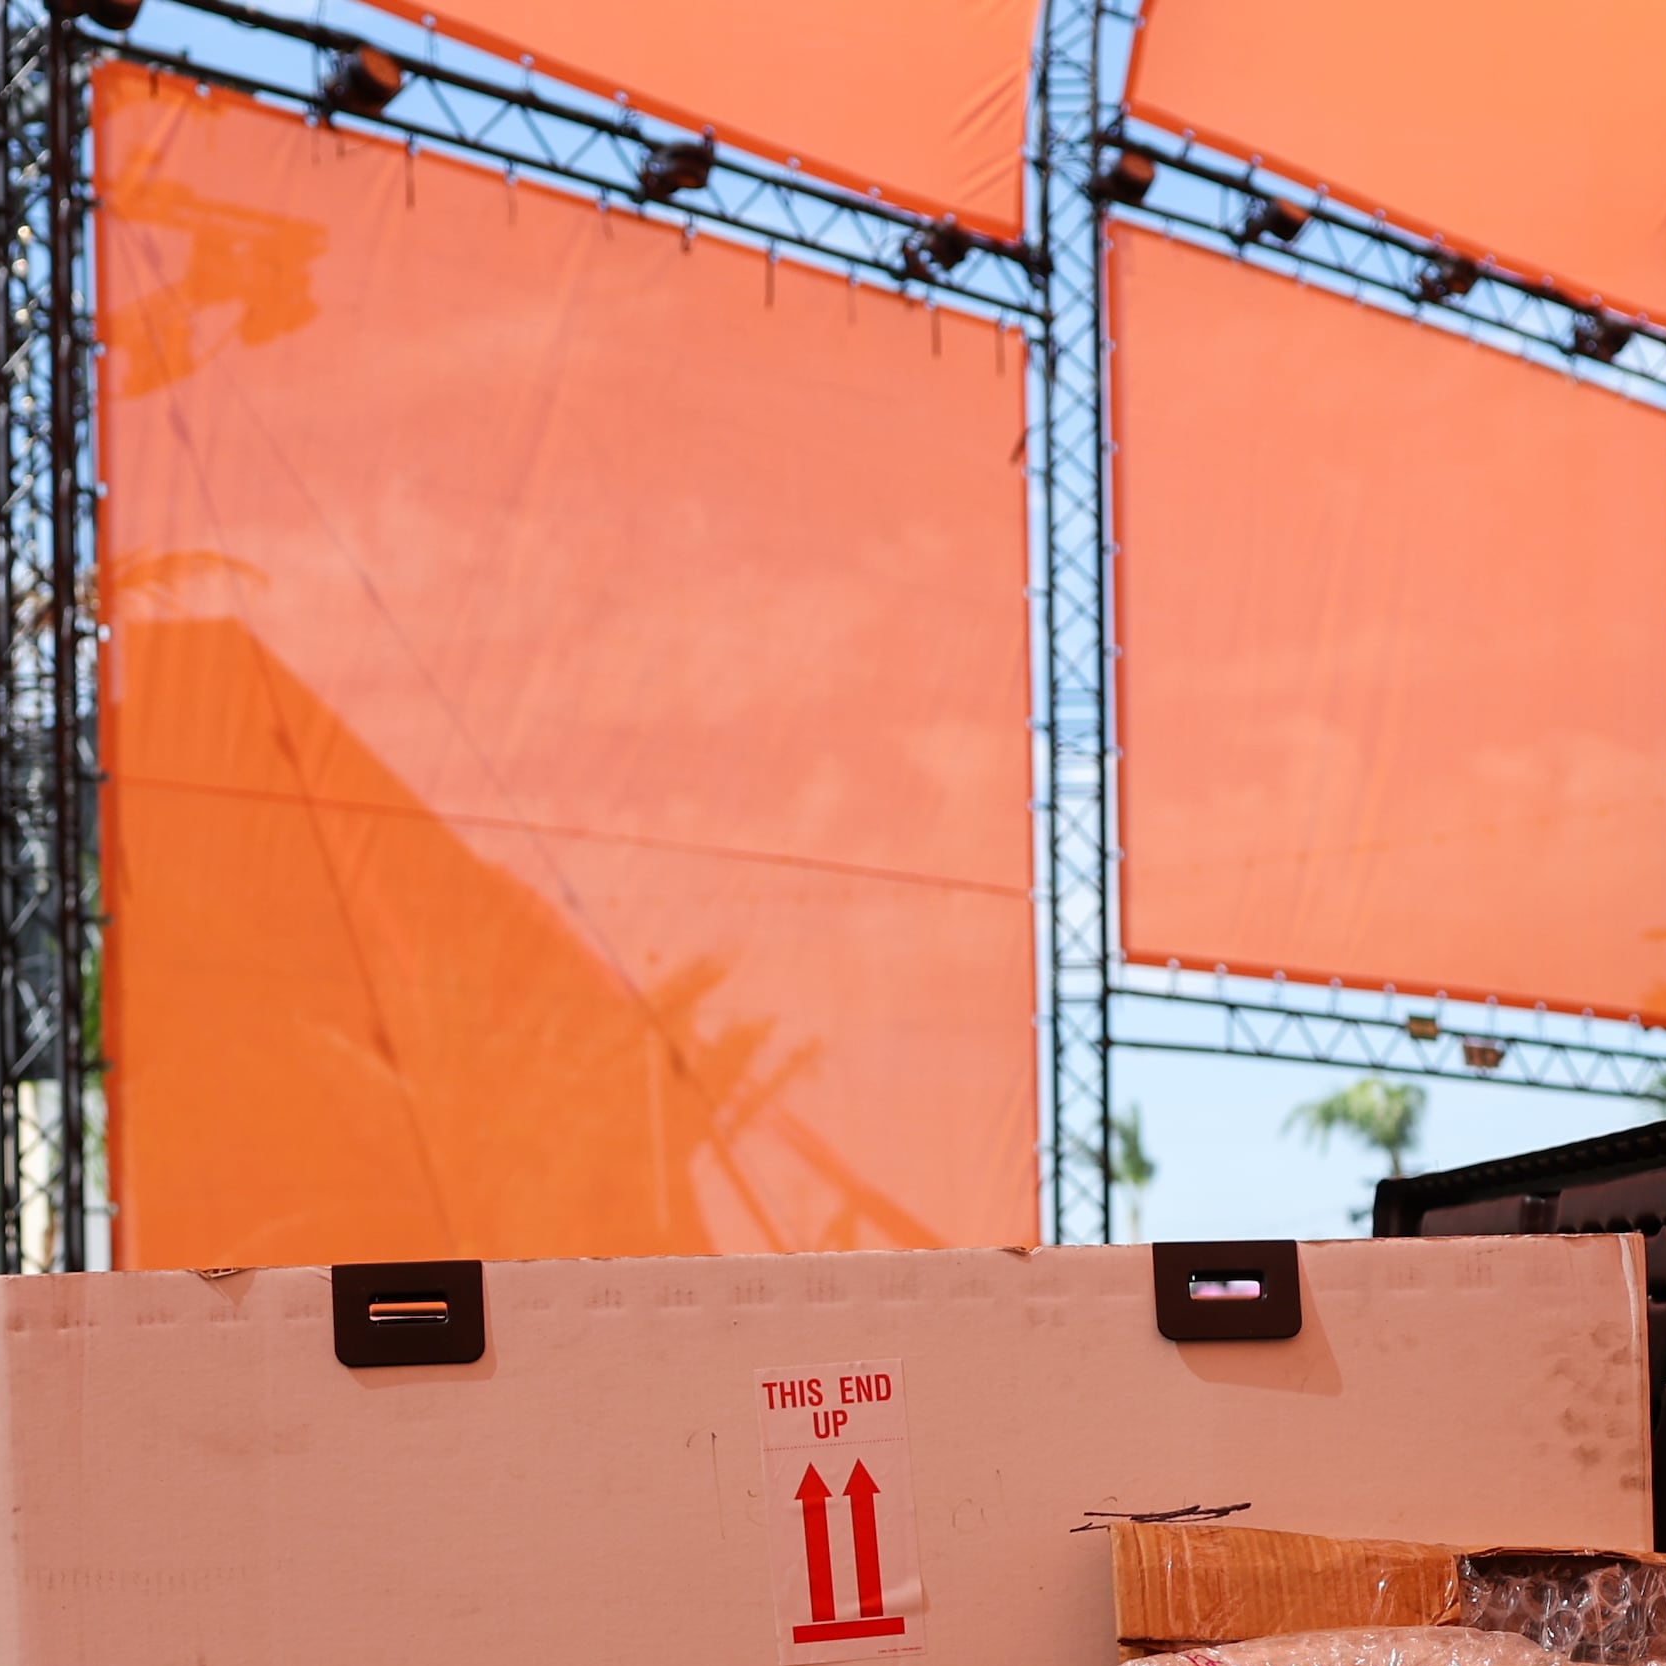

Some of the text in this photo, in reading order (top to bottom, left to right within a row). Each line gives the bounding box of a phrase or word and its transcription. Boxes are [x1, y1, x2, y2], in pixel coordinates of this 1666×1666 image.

[762, 1373, 892, 1410] THIS END
[812, 1409, 848, 1439] UP
